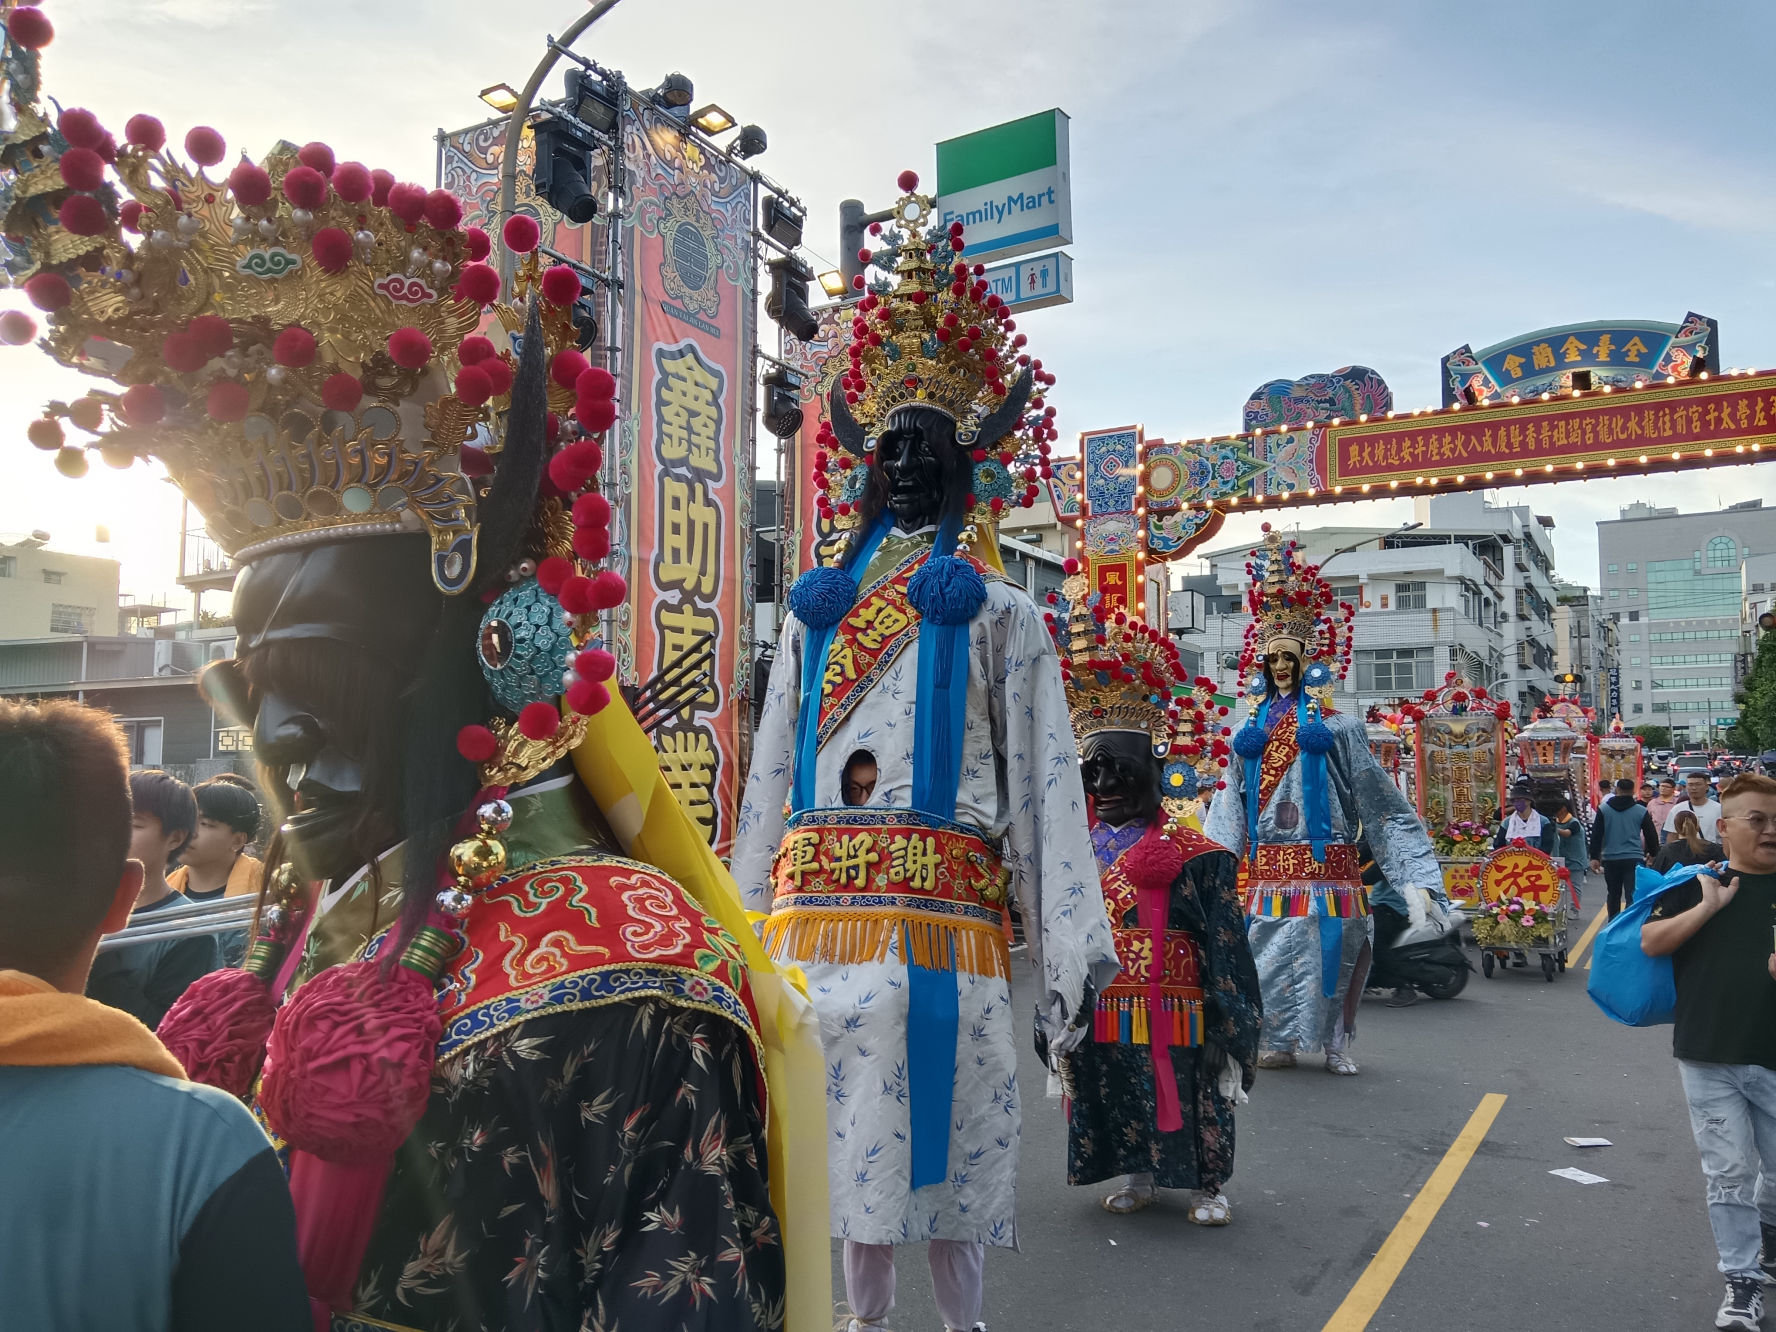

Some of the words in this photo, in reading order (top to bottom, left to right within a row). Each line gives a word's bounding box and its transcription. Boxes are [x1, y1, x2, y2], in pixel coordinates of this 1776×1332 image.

[943, 186, 1055, 228] FamilyMart
[986, 276, 1012, 295] ATM
[1502, 333, 1648, 378] 全臺金蘭會
[786, 831, 941, 891] 謝將軍
